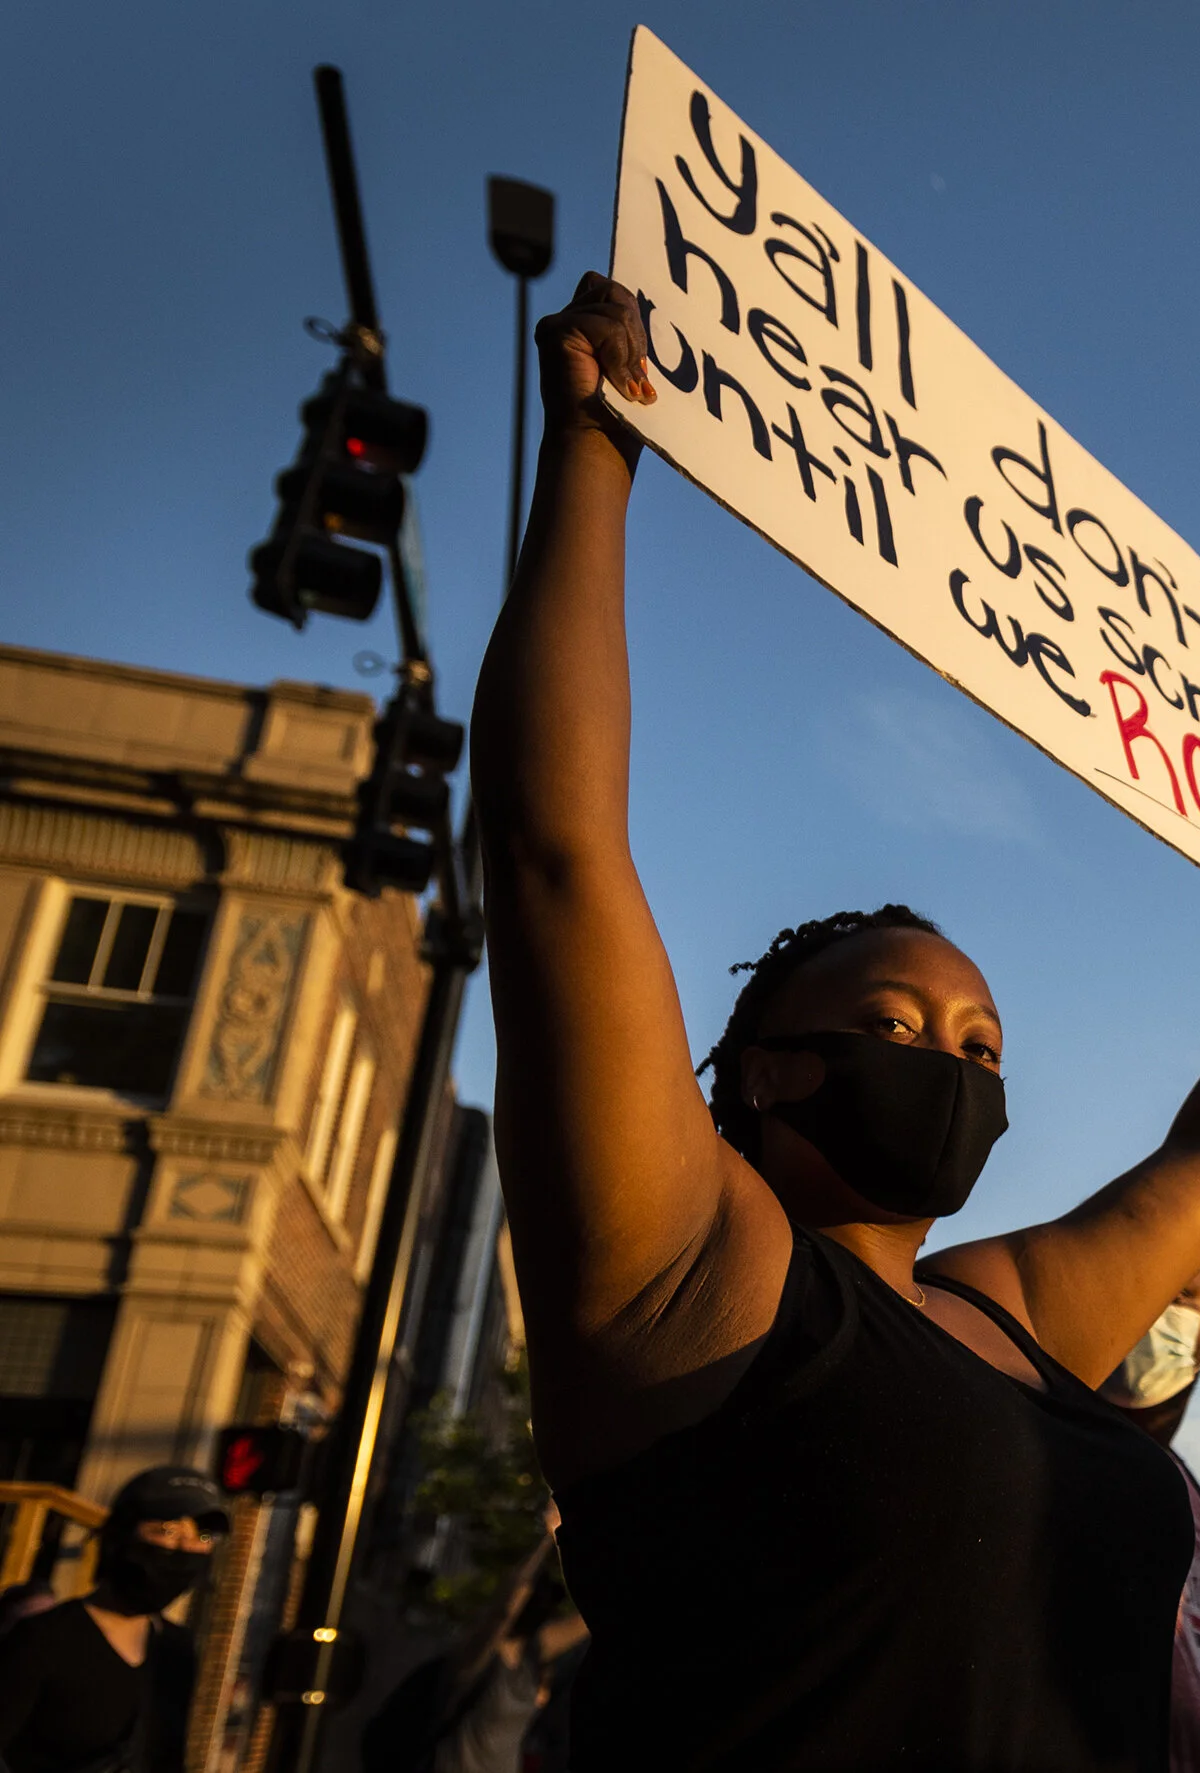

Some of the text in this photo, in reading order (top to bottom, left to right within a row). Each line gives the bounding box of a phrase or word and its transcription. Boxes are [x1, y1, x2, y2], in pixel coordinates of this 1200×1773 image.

[637, 288, 899, 568] until
[949, 567, 1093, 717] we
[655, 176, 948, 497] hear
[964, 495, 1075, 622] us
